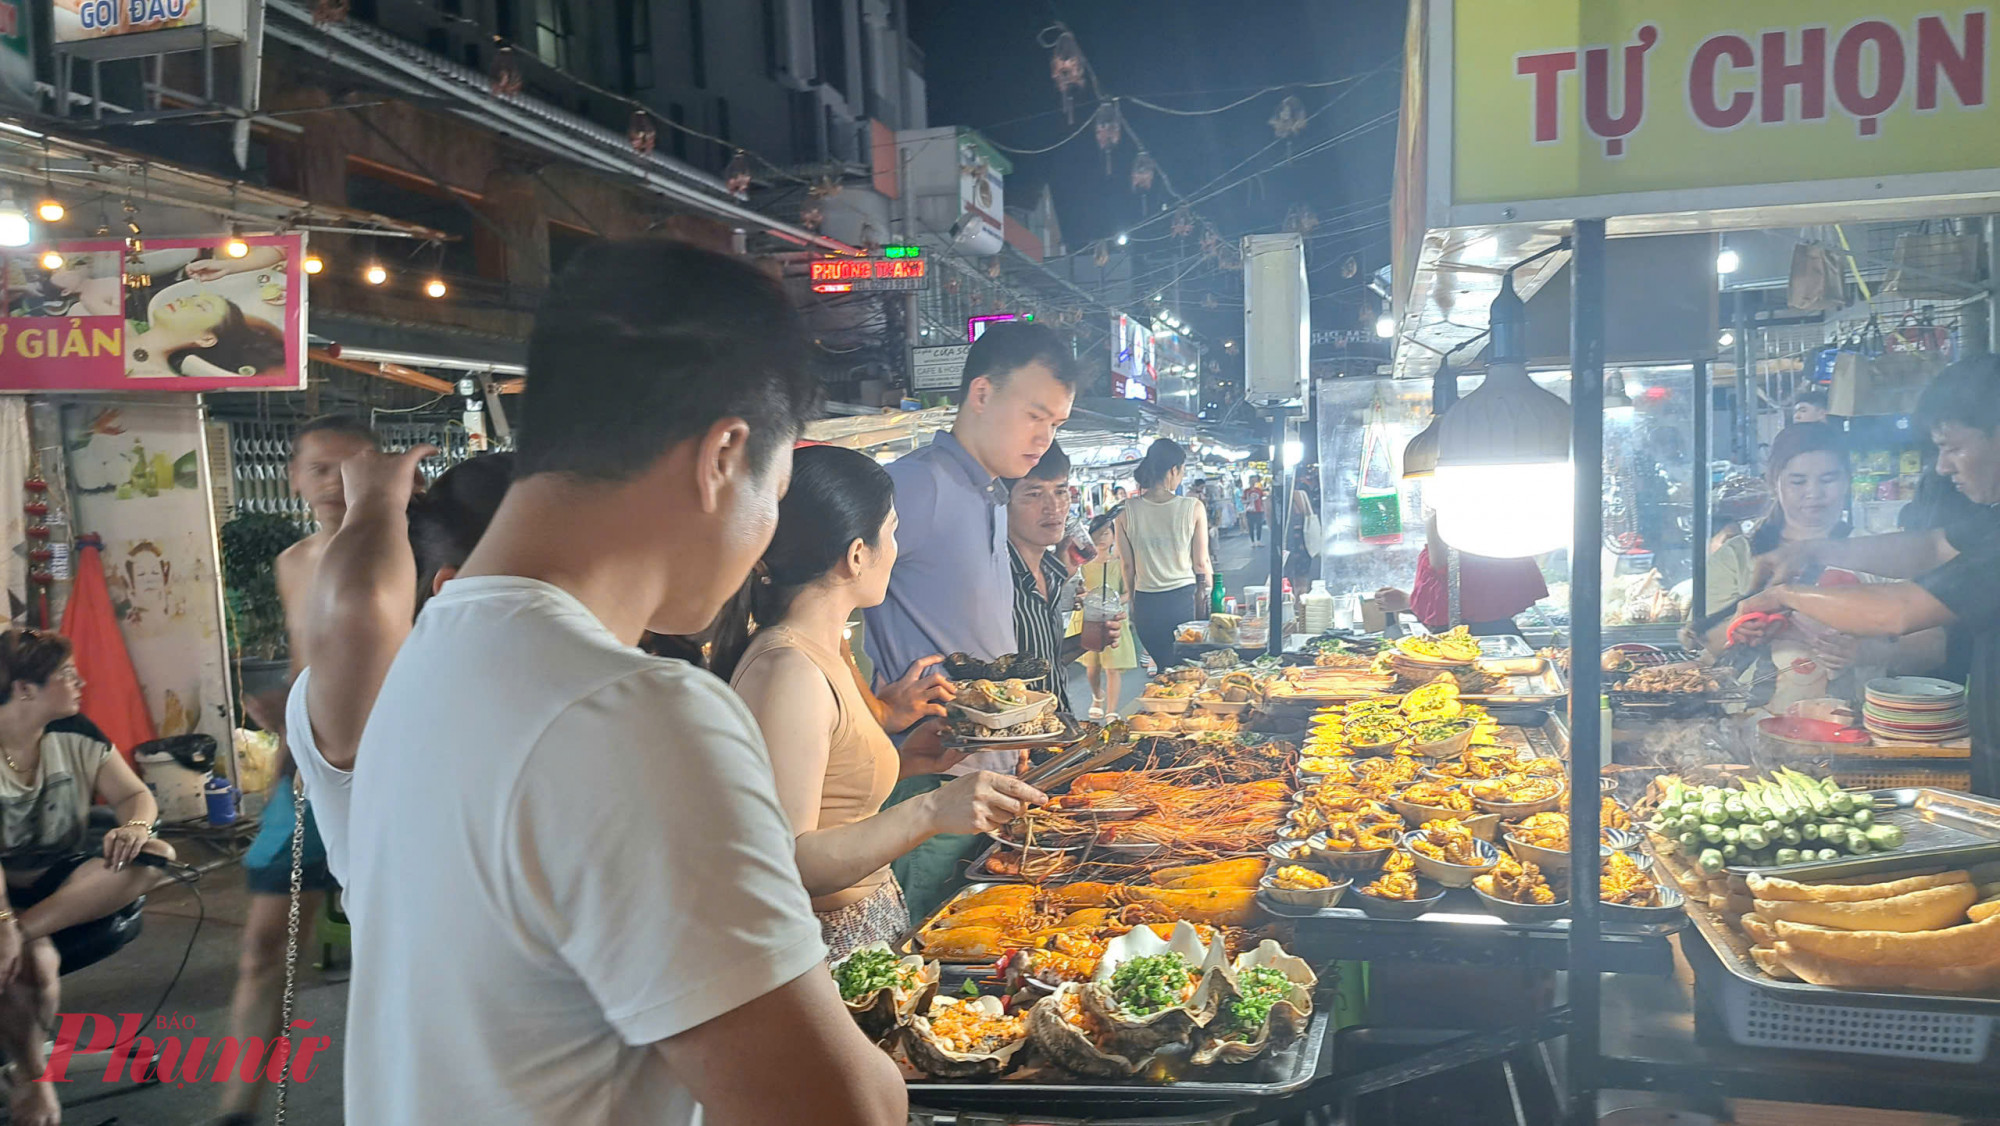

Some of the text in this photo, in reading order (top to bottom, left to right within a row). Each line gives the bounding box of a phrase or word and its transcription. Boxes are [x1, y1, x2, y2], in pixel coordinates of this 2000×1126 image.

[1516, 11, 1986, 156] TỰ CHỌN
[16, 318, 122, 359] GIẢN
